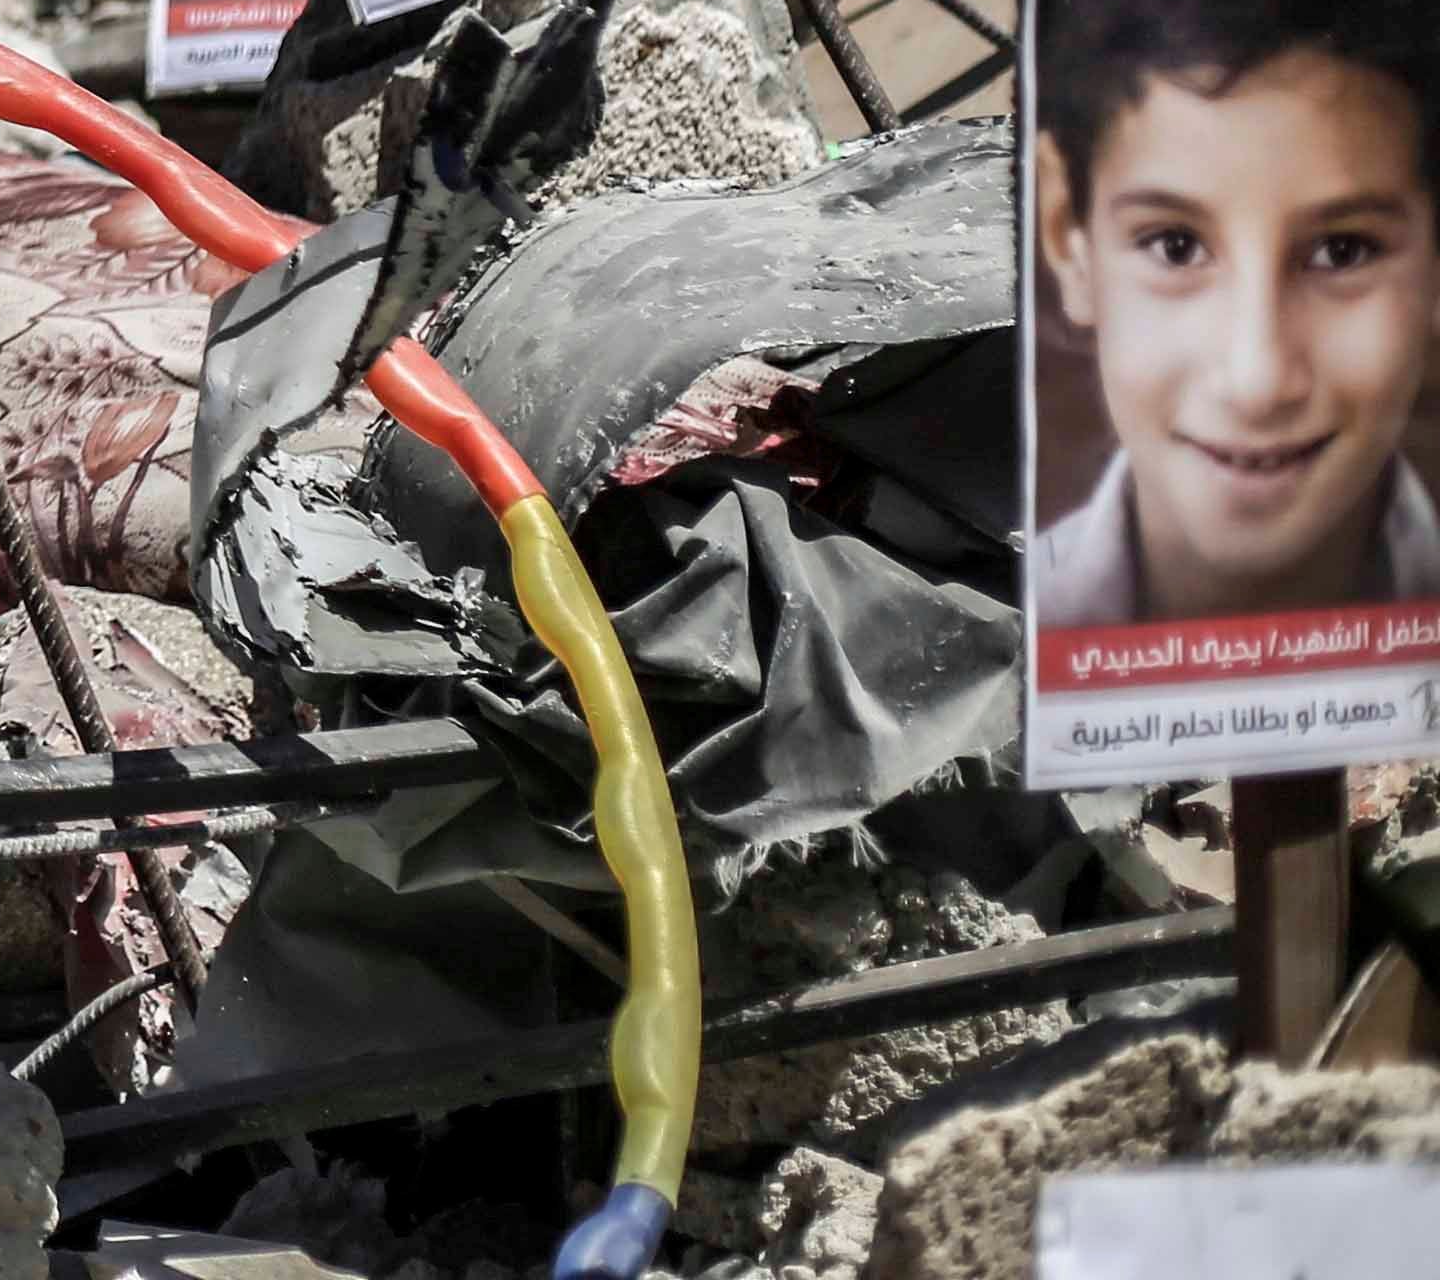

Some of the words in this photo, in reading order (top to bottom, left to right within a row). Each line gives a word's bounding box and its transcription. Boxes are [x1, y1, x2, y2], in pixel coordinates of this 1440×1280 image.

[1190, 637, 1262, 668] يحيى
[1268, 619, 1370, 663] الشهيد/
[1376, 617, 1440, 655] لطفل
[1071, 636, 1183, 679] الحديدي
[1071, 714, 1161, 753] الخيرية
[1168, 710, 1225, 748] نحلم
[1231, 706, 1289, 737] بطلنا
[1296, 700, 1317, 735] لو
[1324, 700, 1398, 731] جمعية
